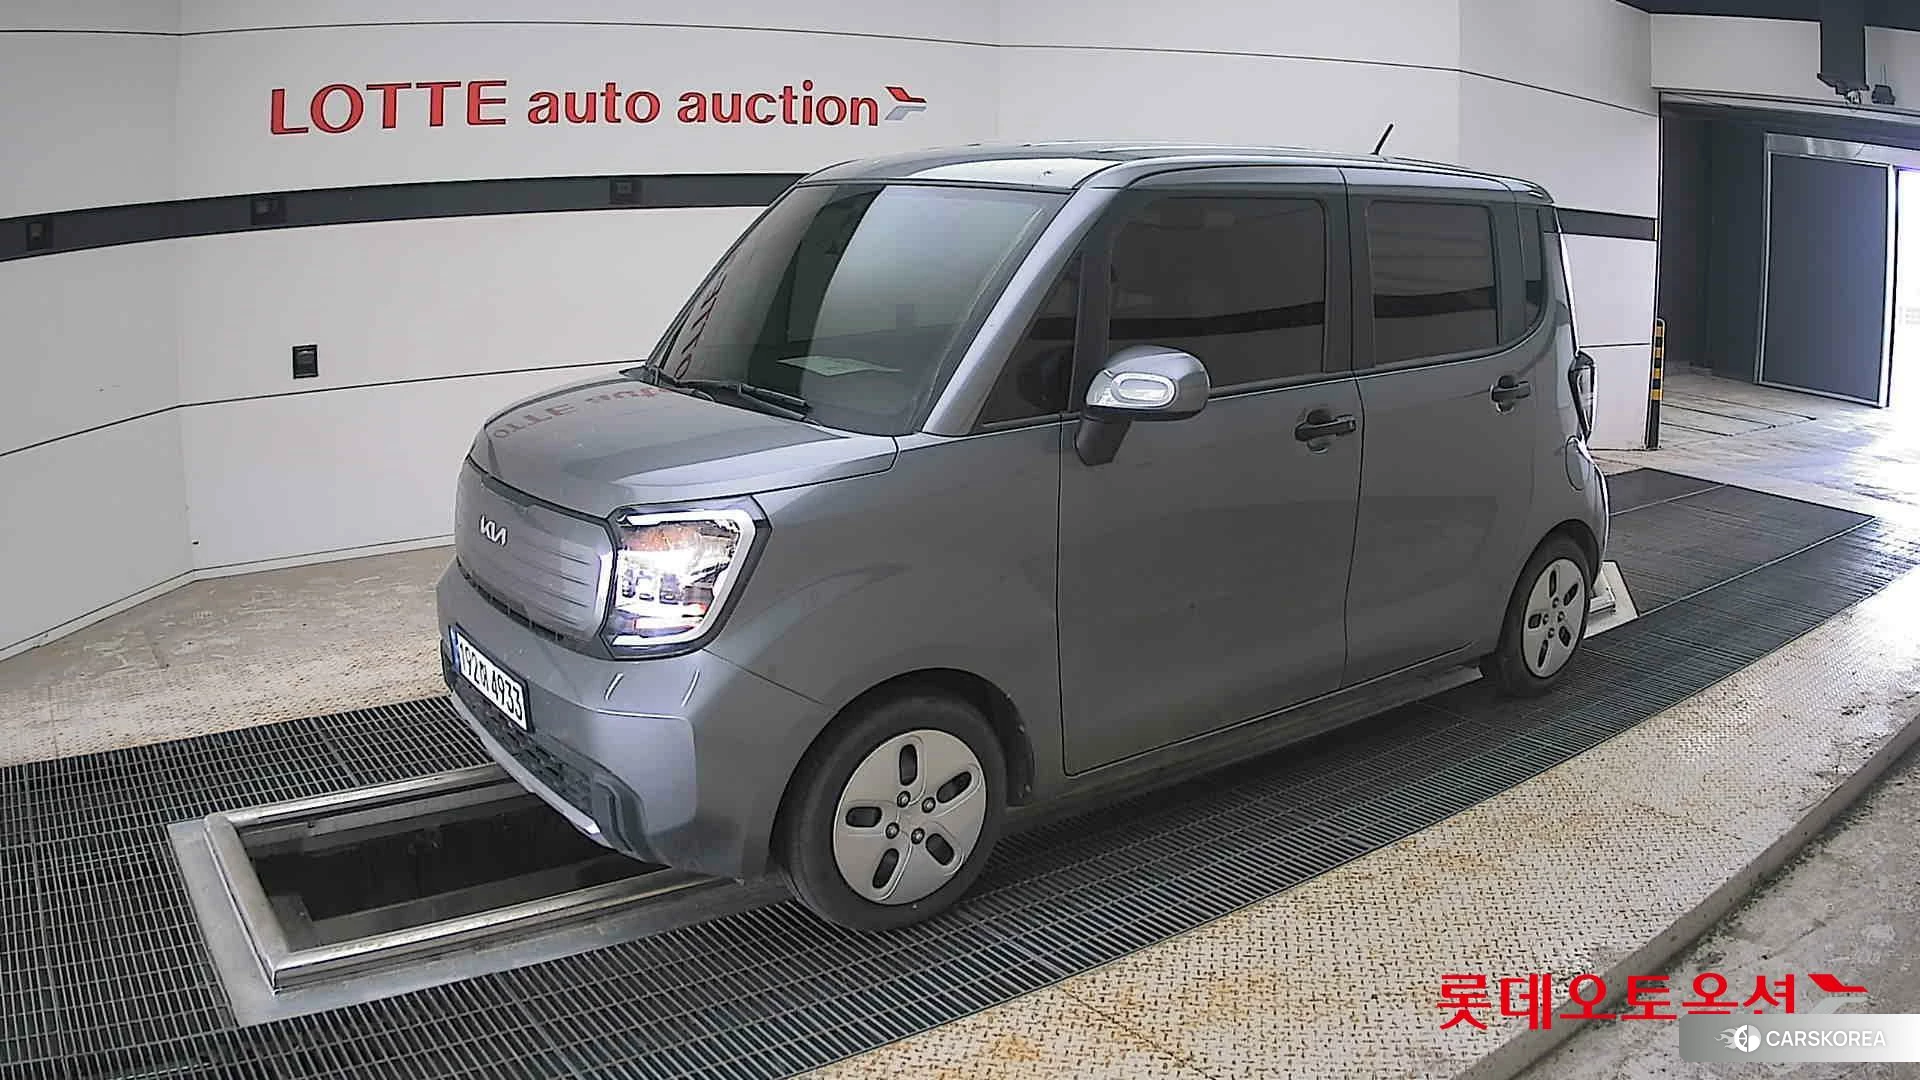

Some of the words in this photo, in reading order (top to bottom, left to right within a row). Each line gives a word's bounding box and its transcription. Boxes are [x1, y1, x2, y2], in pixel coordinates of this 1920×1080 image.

[270, 80, 508, 135] LOTTE
[527, 82, 661, 124] auto
[677, 80, 879, 126] auction
[491, 670, 523, 721] 4933
